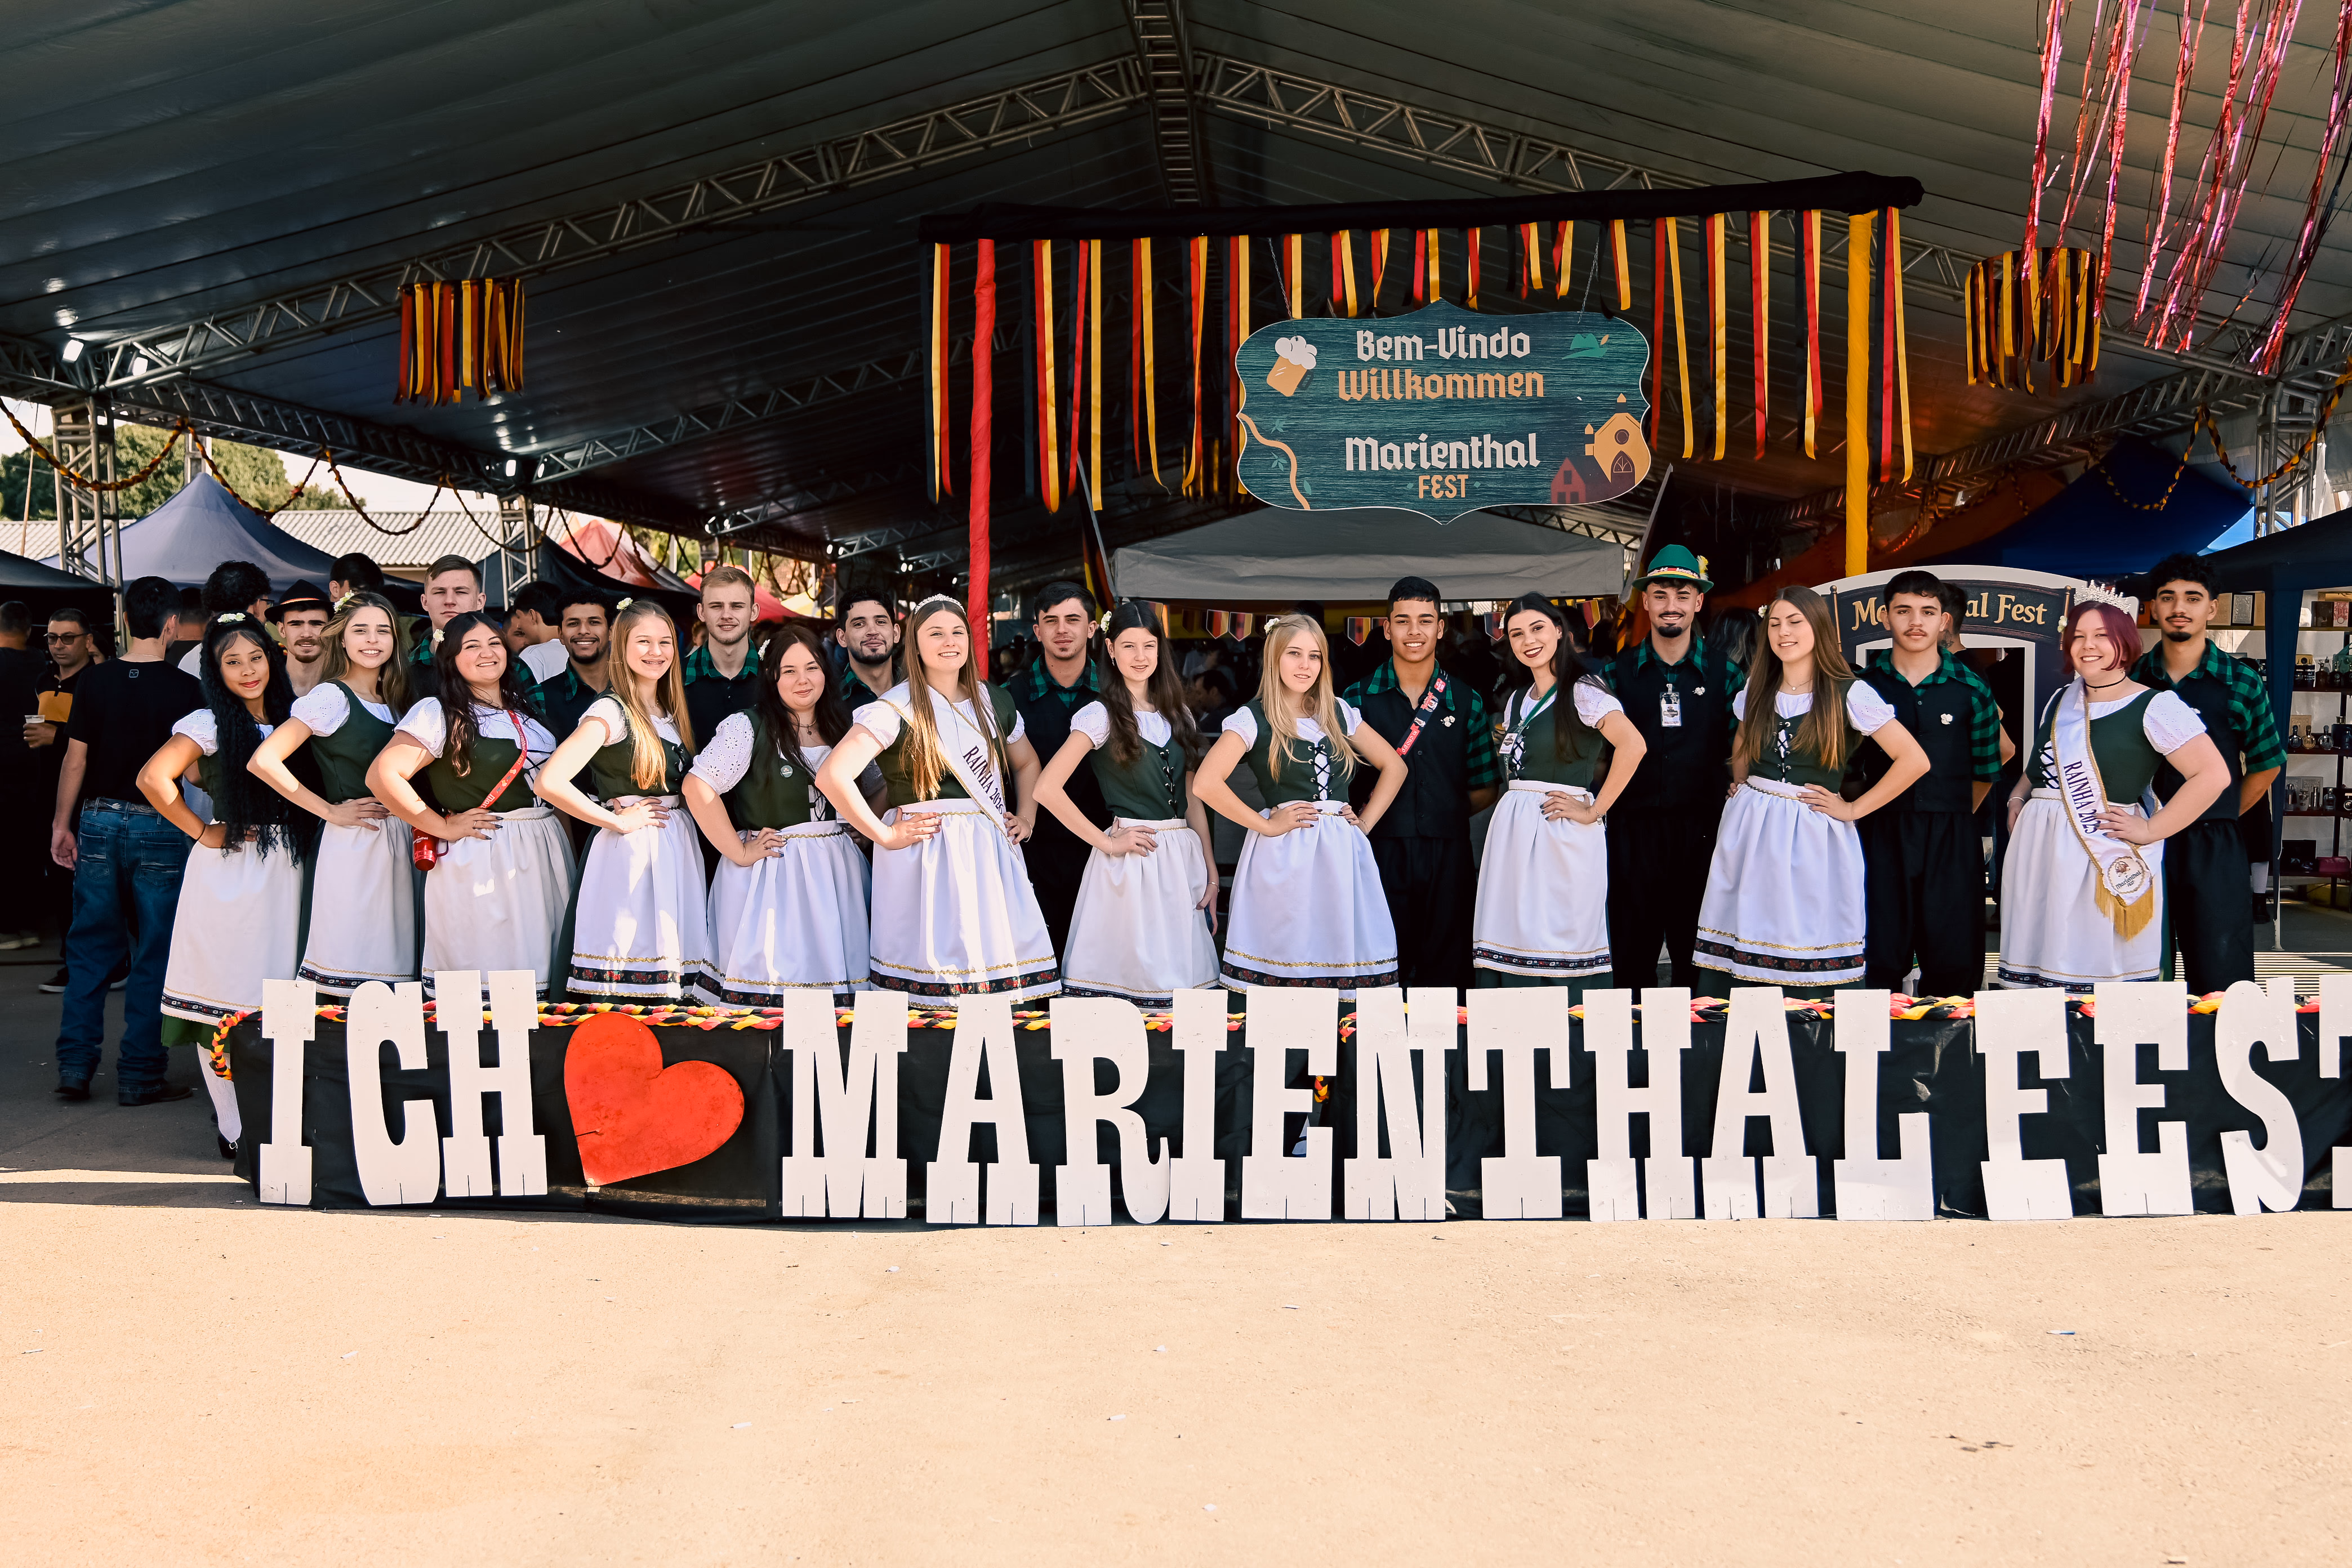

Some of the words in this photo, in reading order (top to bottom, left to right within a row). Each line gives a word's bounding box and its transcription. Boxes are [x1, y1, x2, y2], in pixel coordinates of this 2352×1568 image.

[1356, 326, 1531, 362] Bem-Vindo
[1337, 367, 1544, 402] Willkommen
[1345, 433, 1542, 471] Marienthal
[1418, 475, 1469, 498] FEST
[1994, 594, 2048, 625] Fest
[963, 745, 994, 794] RAINHA
[989, 787, 1003, 814] 2026
[2064, 760, 2096, 810] RAINHA
[260, 969, 547, 1206] ICH
[782, 986, 1934, 1226] MARIENTHAL
